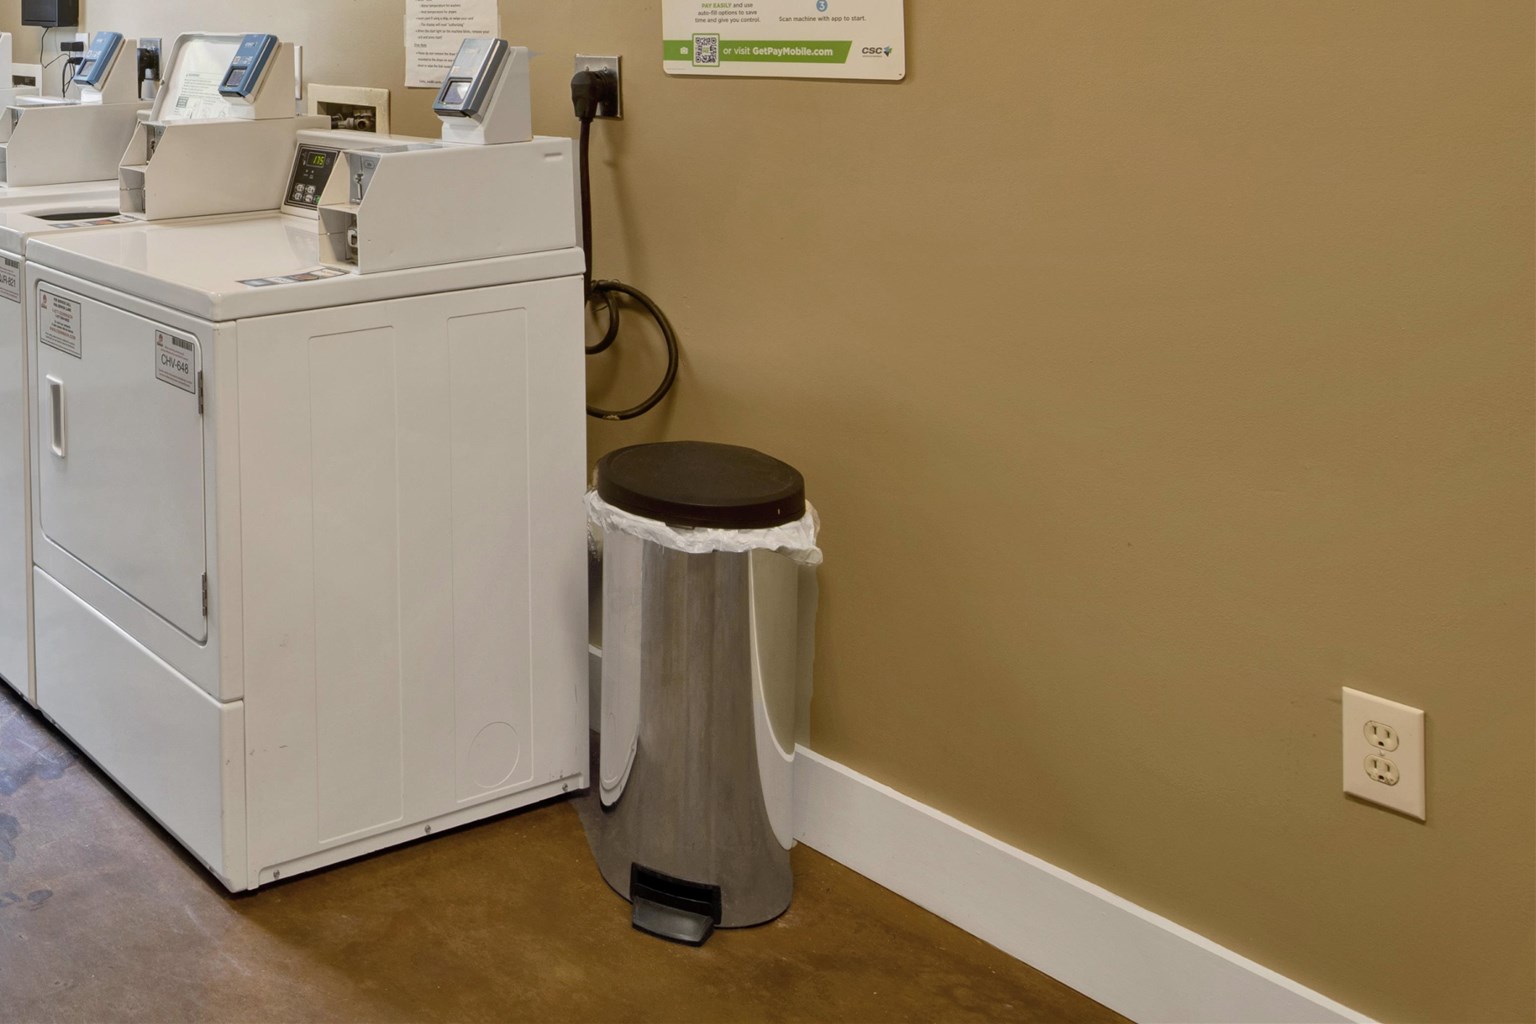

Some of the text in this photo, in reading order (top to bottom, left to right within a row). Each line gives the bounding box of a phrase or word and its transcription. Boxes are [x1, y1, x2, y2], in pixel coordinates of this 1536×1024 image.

[819, 1, 825, 10] 3
[723, 45, 833, 57] or visit GetPayMobile.com
[862, 47, 883, 55] CSC
[161, 354, 188, 374] CHV-648
